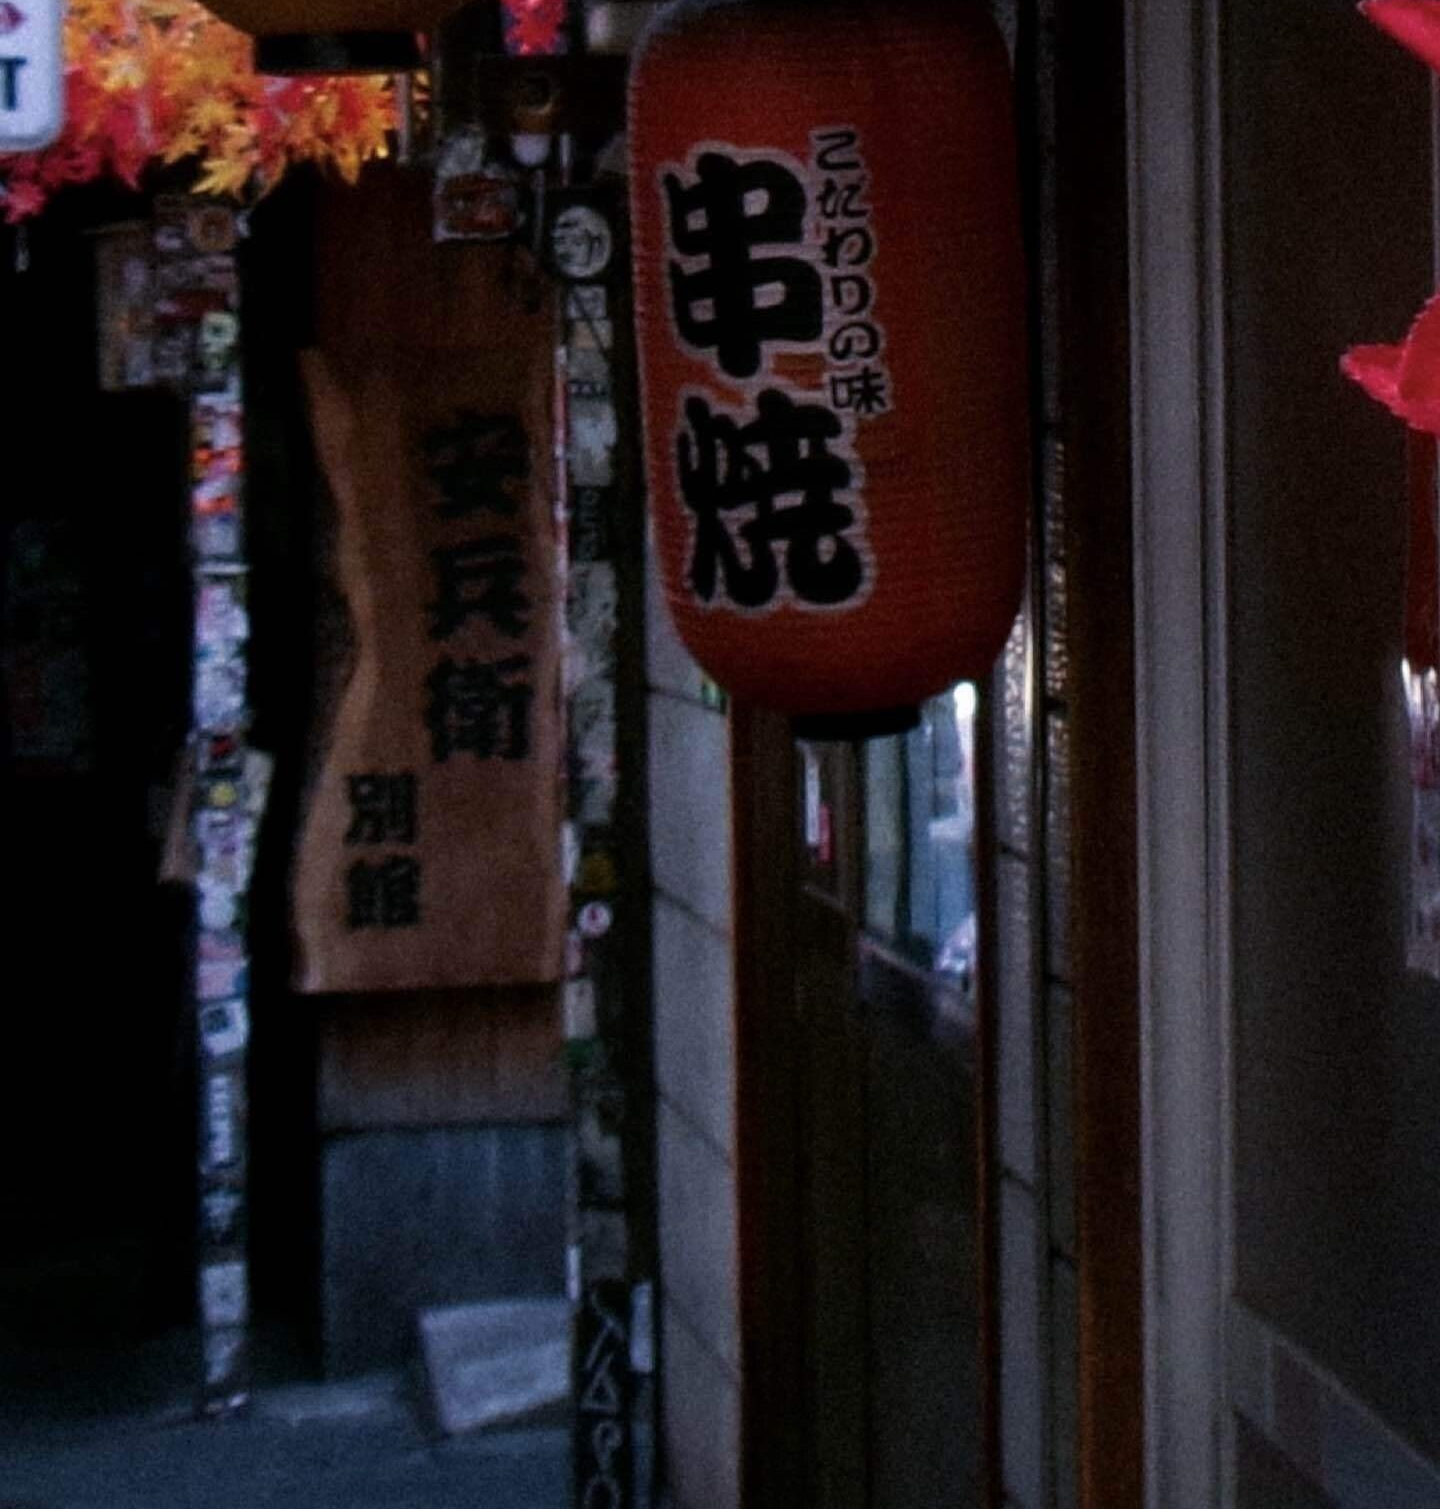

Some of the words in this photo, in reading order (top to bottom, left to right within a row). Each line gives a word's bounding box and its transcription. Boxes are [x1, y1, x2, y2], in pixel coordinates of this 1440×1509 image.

[658, 146, 870, 611] 串焼
[813, 130, 888, 414] こだわりの味
